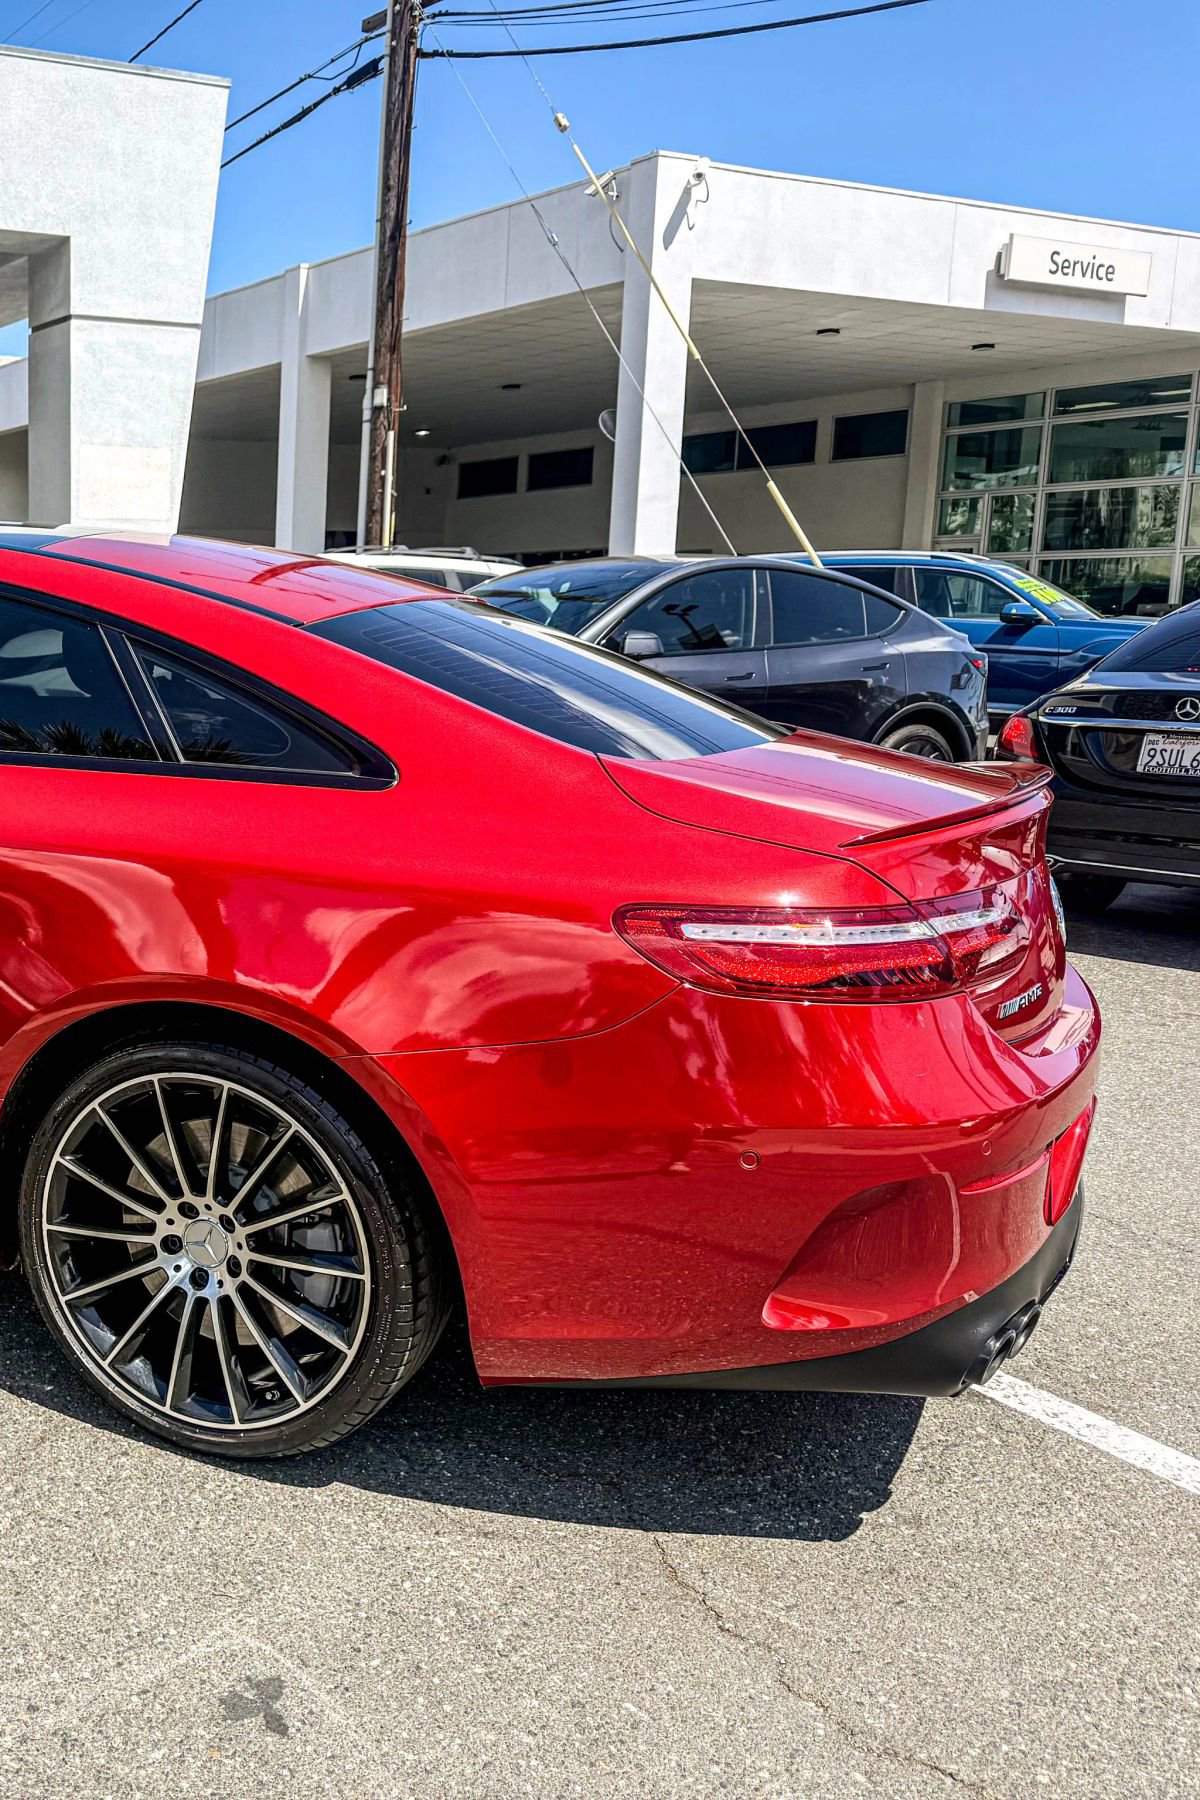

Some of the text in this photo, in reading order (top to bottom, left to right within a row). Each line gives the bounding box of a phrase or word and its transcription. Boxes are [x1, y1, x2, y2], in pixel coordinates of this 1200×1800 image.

[1048, 250, 1116, 283] Service
[1144, 748, 1200, 769] 9SUL6
[1145, 766, 1187, 775] FOOTHILL
